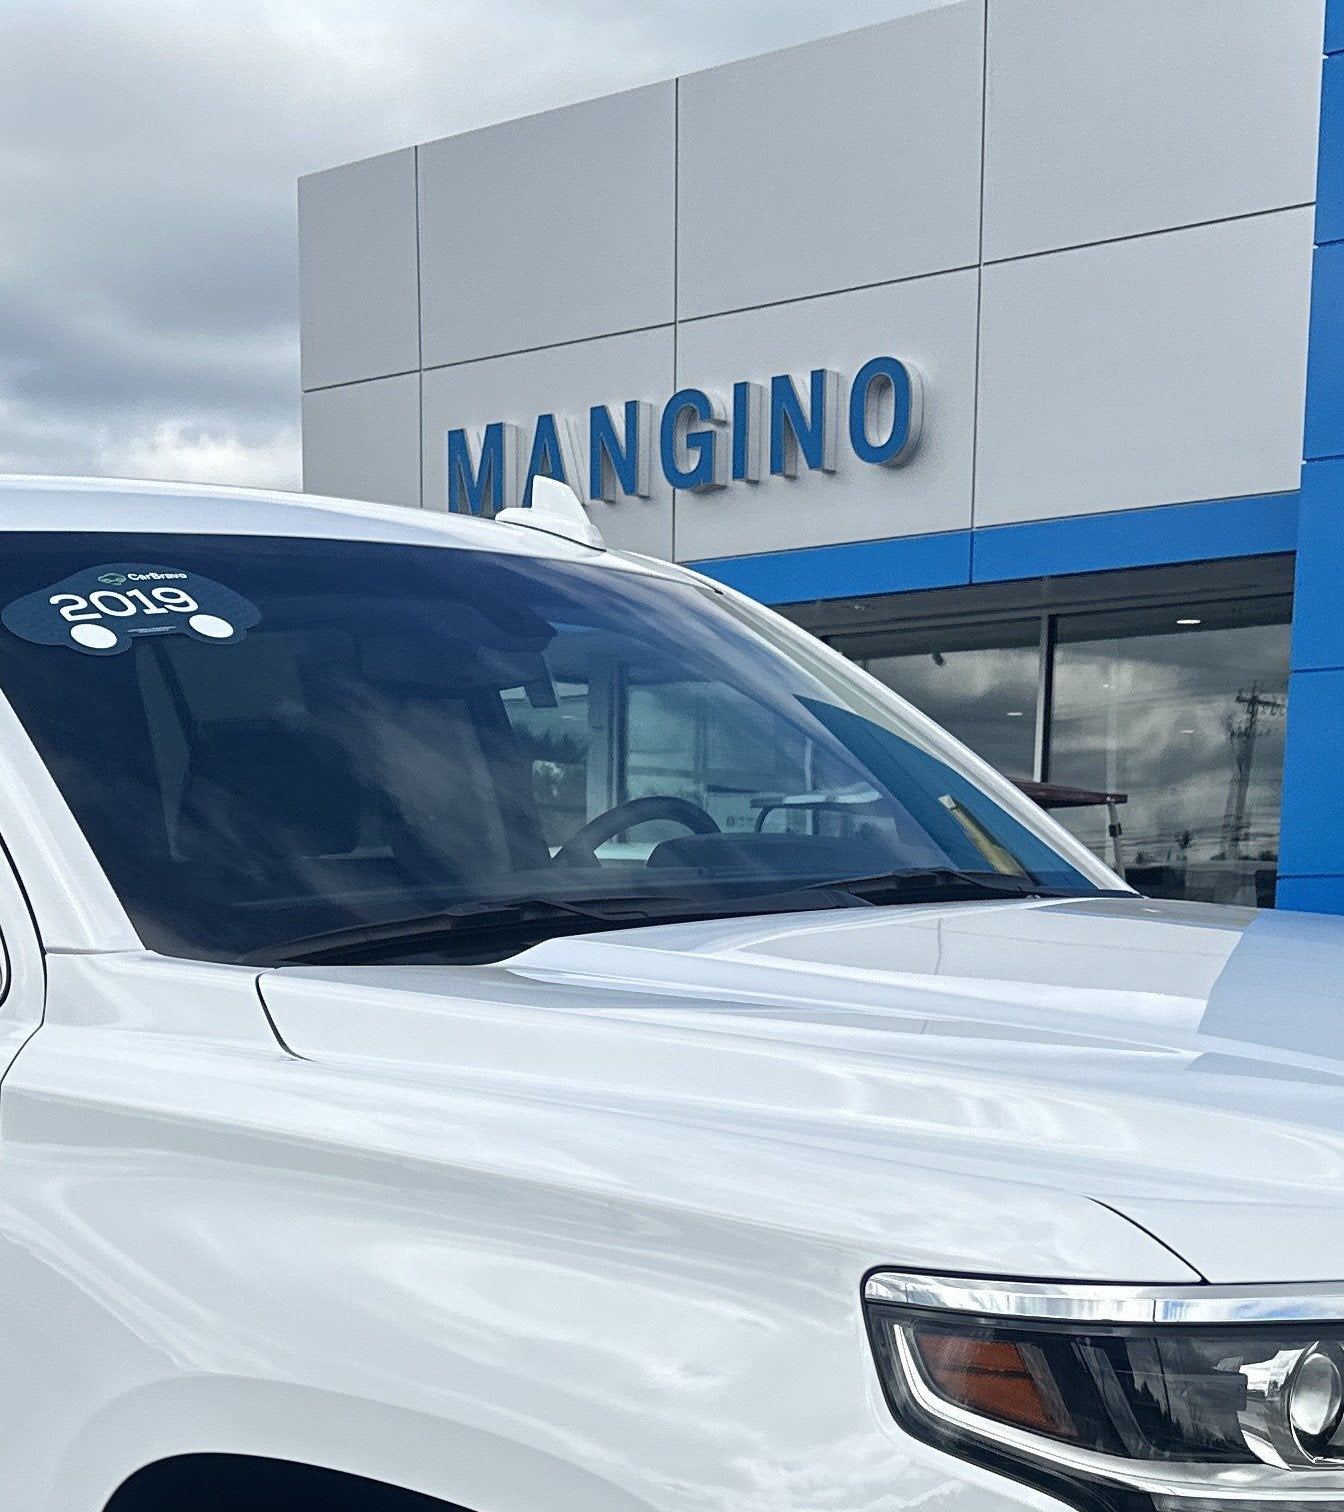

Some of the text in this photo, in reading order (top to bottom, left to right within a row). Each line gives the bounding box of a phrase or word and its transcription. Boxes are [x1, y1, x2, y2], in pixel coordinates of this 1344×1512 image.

[447, 356, 918, 515] MANGINO
[127, 572, 188, 581] CarBravo
[49, 587, 199, 622] 2019
